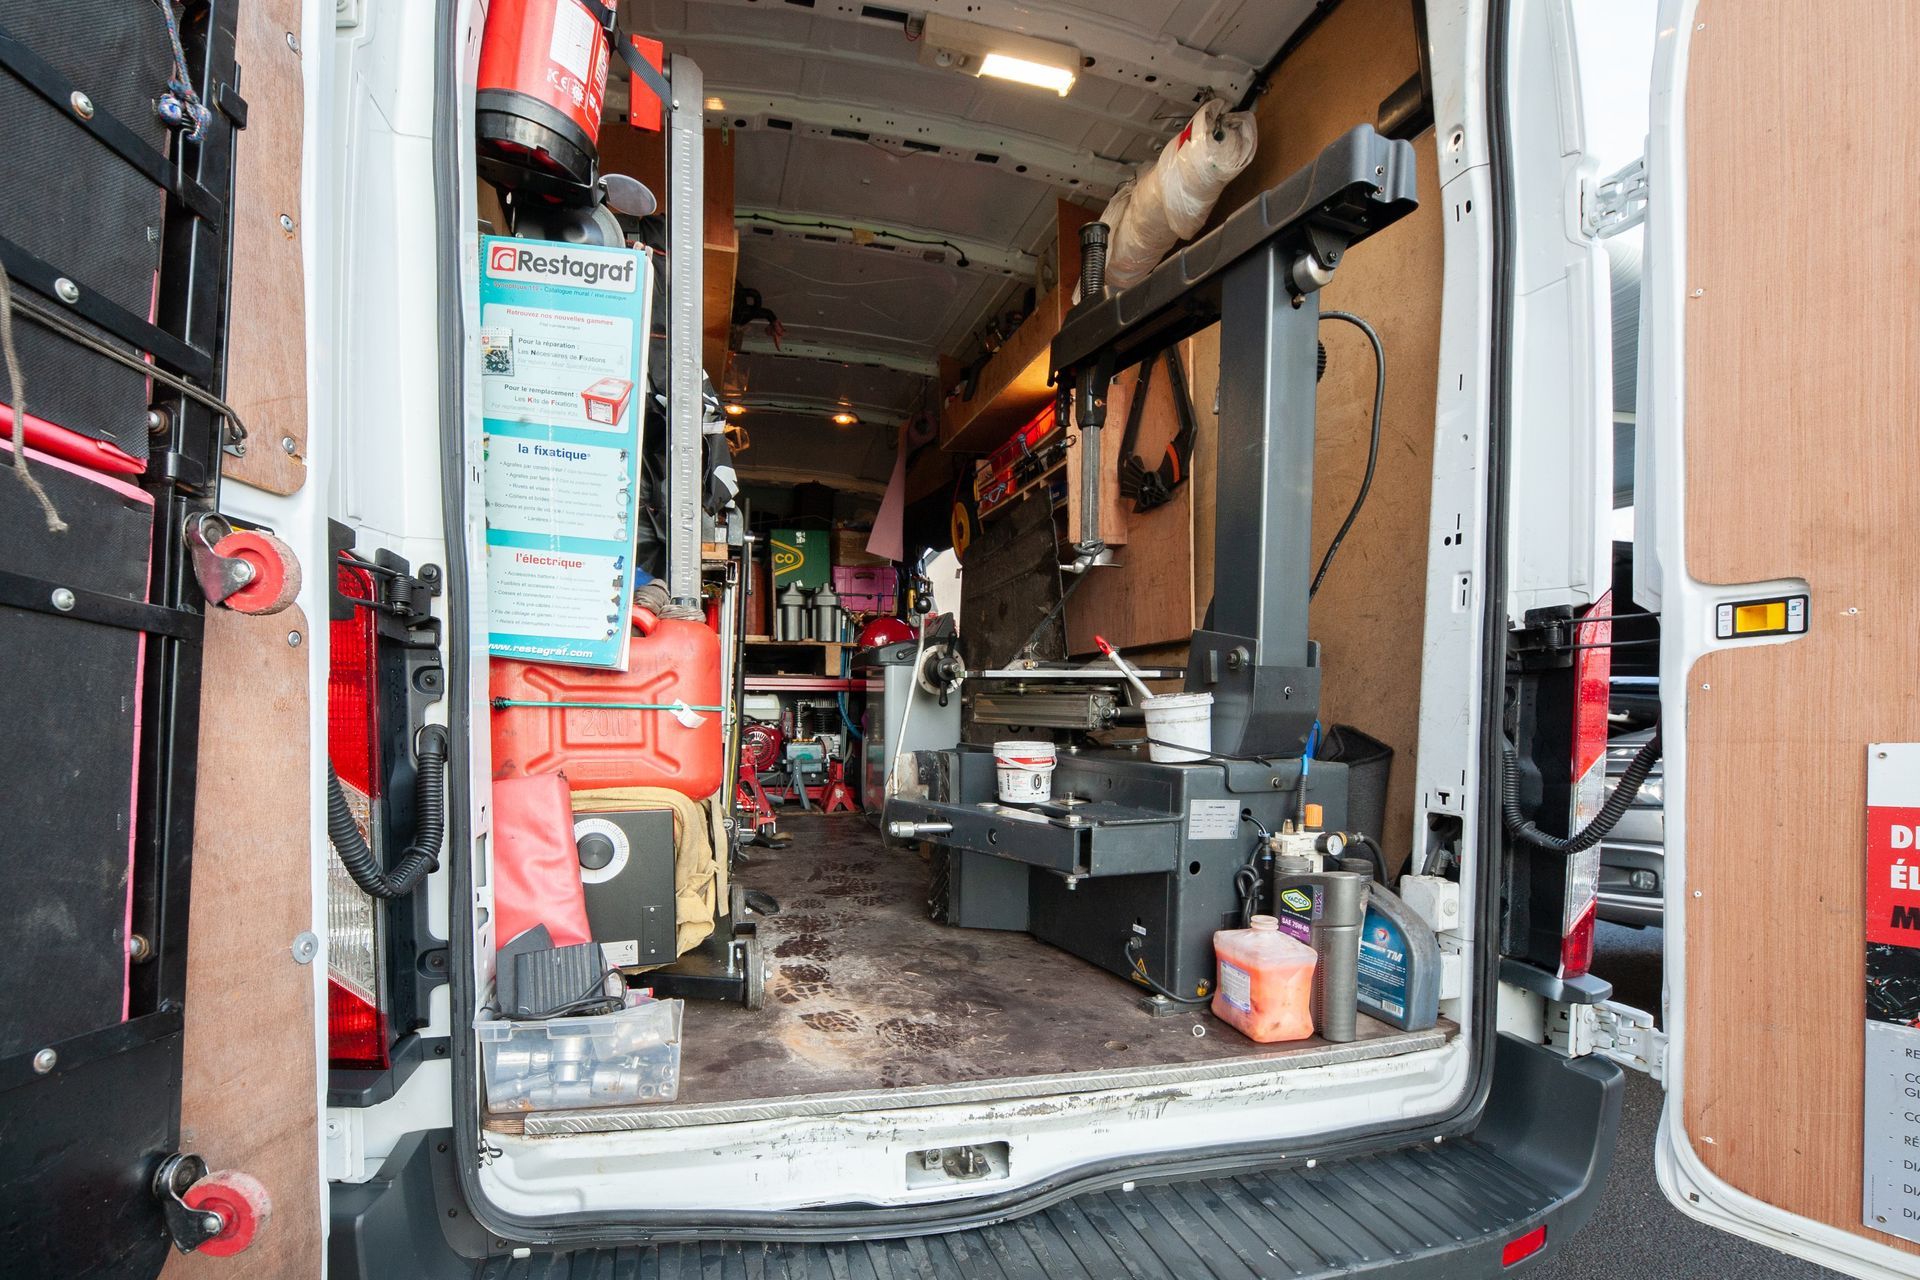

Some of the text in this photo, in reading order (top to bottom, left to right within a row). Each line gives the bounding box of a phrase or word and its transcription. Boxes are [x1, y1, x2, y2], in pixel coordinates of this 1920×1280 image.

[518, 250, 634, 285] Restagraf
[544, 286, 573, 296] Catalogue
[506, 308, 539, 318] Retrouvez
[554, 313, 585, 323] nouvelles
[586, 317, 614, 326] gammes
[518, 337, 533, 345] Pour
[542, 340, 576, 350] réparation
[578, 355, 606, 363] Fixations
[504, 383, 519, 391] Pour
[528, 387, 574, 398] remplacement
[527, 396, 540, 404] Kits
[550, 399, 578, 408] Fixations
[518, 443, 529, 454] la
[775, 553, 794, 564] CO
[1891, 824, 1920, 850] D
[1387, 949, 1403, 963] TM
[1903, 1159, 1920, 1172] DI
[1903, 1183, 1920, 1196] DI
[1903, 1207, 1920, 1220] DI
